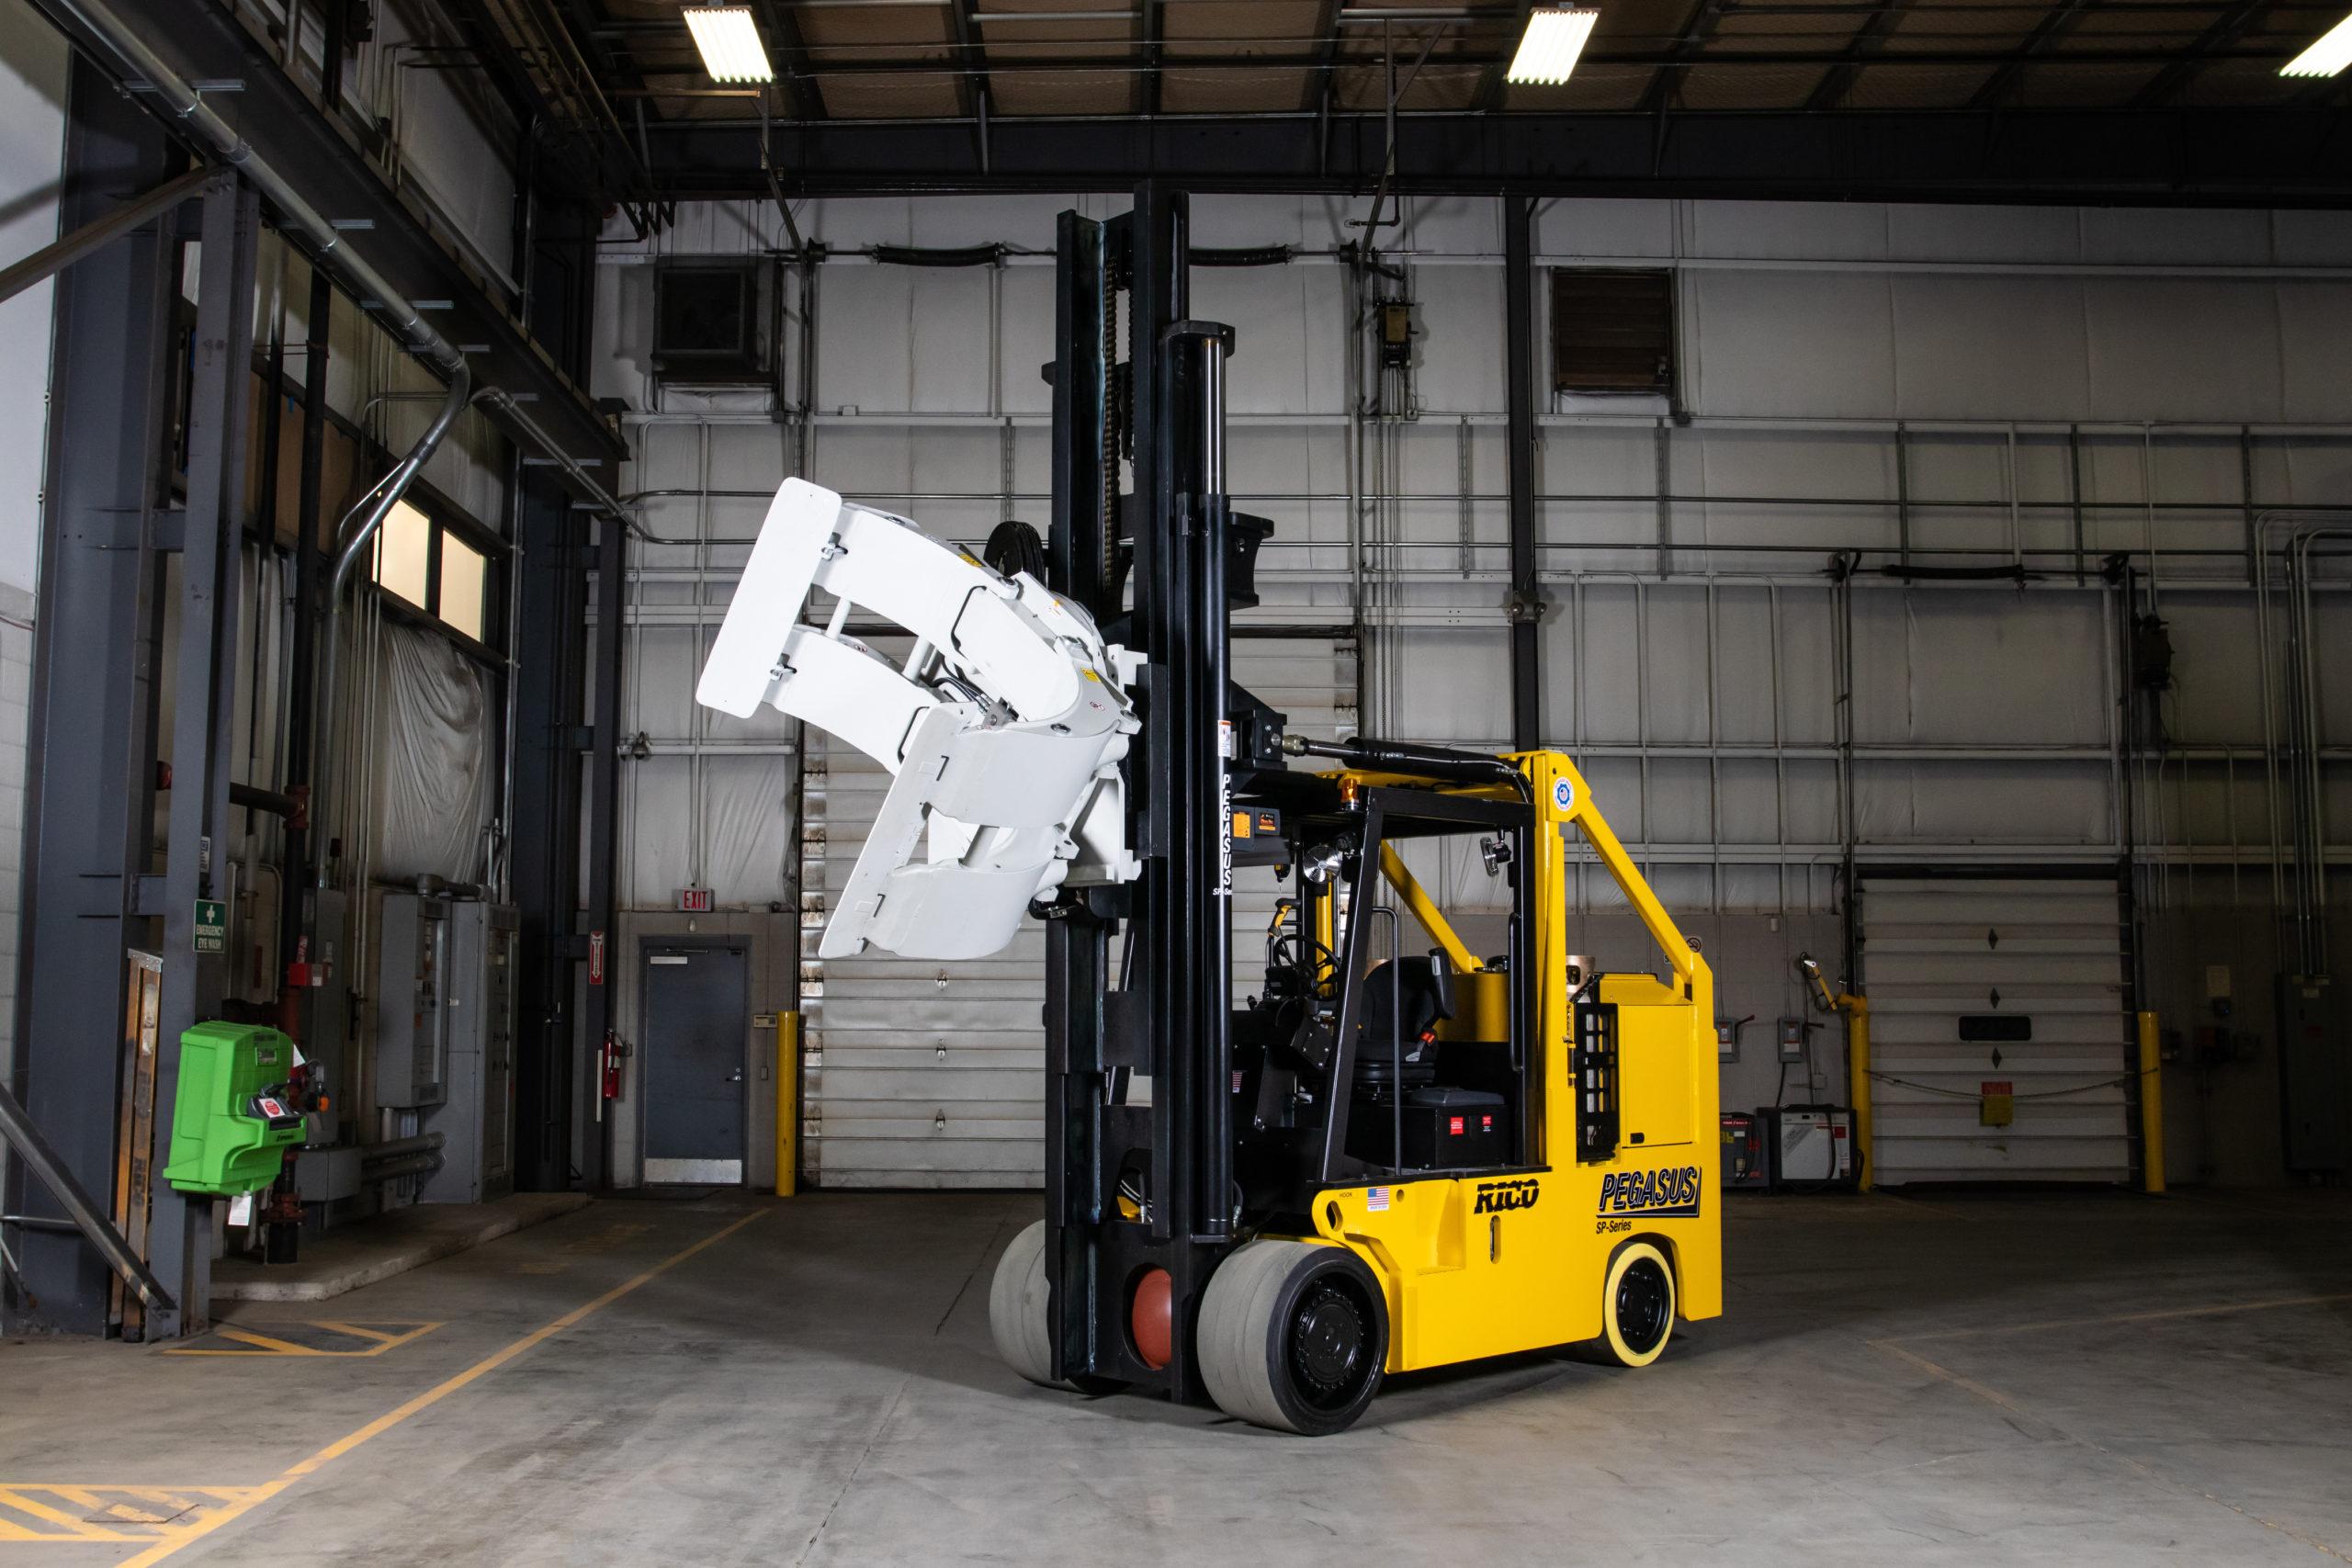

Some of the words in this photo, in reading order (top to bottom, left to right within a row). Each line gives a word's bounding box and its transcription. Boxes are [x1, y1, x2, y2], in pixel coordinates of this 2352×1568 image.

[1222, 773, 1232, 886] PEGASUS
[684, 890, 707, 909] EXIT
[196, 924, 224, 938] EMERGENCY
[198, 938, 208, 949] EYE
[208, 938, 222, 950] WASH
[1474, 1179, 1540, 1214] RICO
[1599, 1166, 1698, 1212] PEGASUS
[1596, 1219, 1632, 1235] SP-Series
